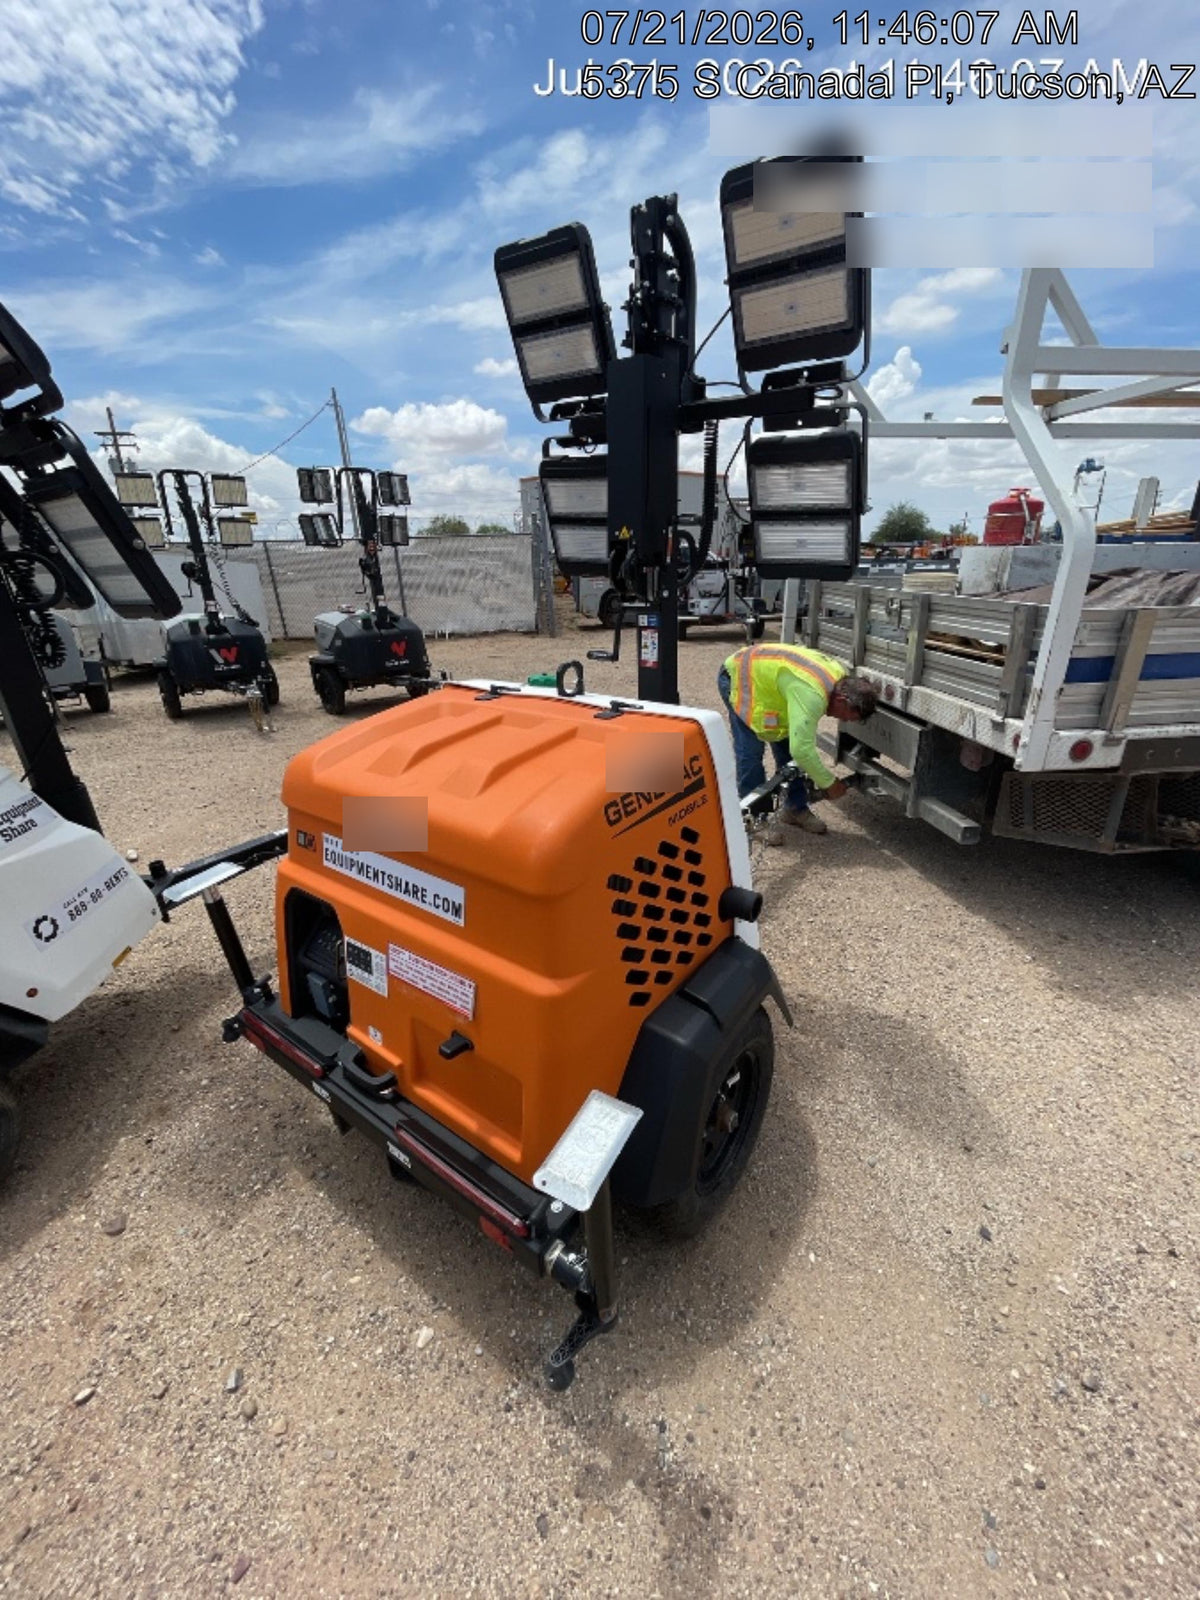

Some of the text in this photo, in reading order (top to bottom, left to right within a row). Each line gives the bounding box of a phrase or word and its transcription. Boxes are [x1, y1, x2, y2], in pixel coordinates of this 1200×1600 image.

[0, 796, 43, 825] quipment
[0, 818, 38, 843] Share
[324, 847, 463, 920] EQUIPMENTSHARE.COM
